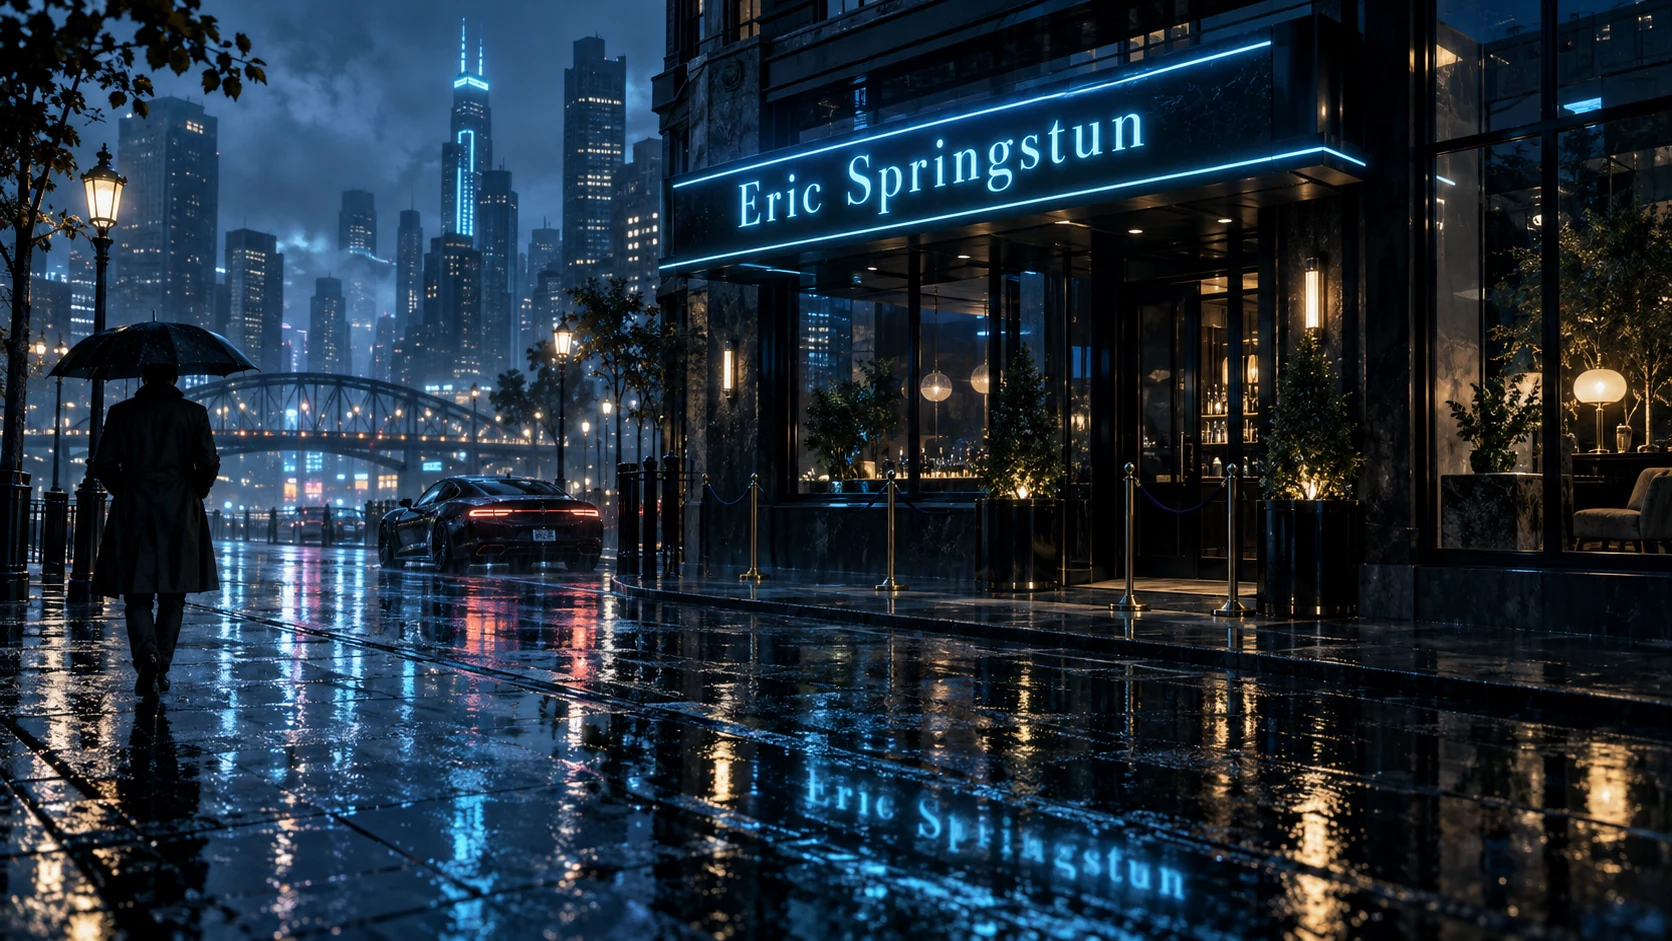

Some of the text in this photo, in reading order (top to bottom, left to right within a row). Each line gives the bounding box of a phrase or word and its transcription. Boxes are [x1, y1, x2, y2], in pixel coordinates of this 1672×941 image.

[737, 112, 1145, 228] Eric Springstun
[806, 769, 895, 821] Eric
